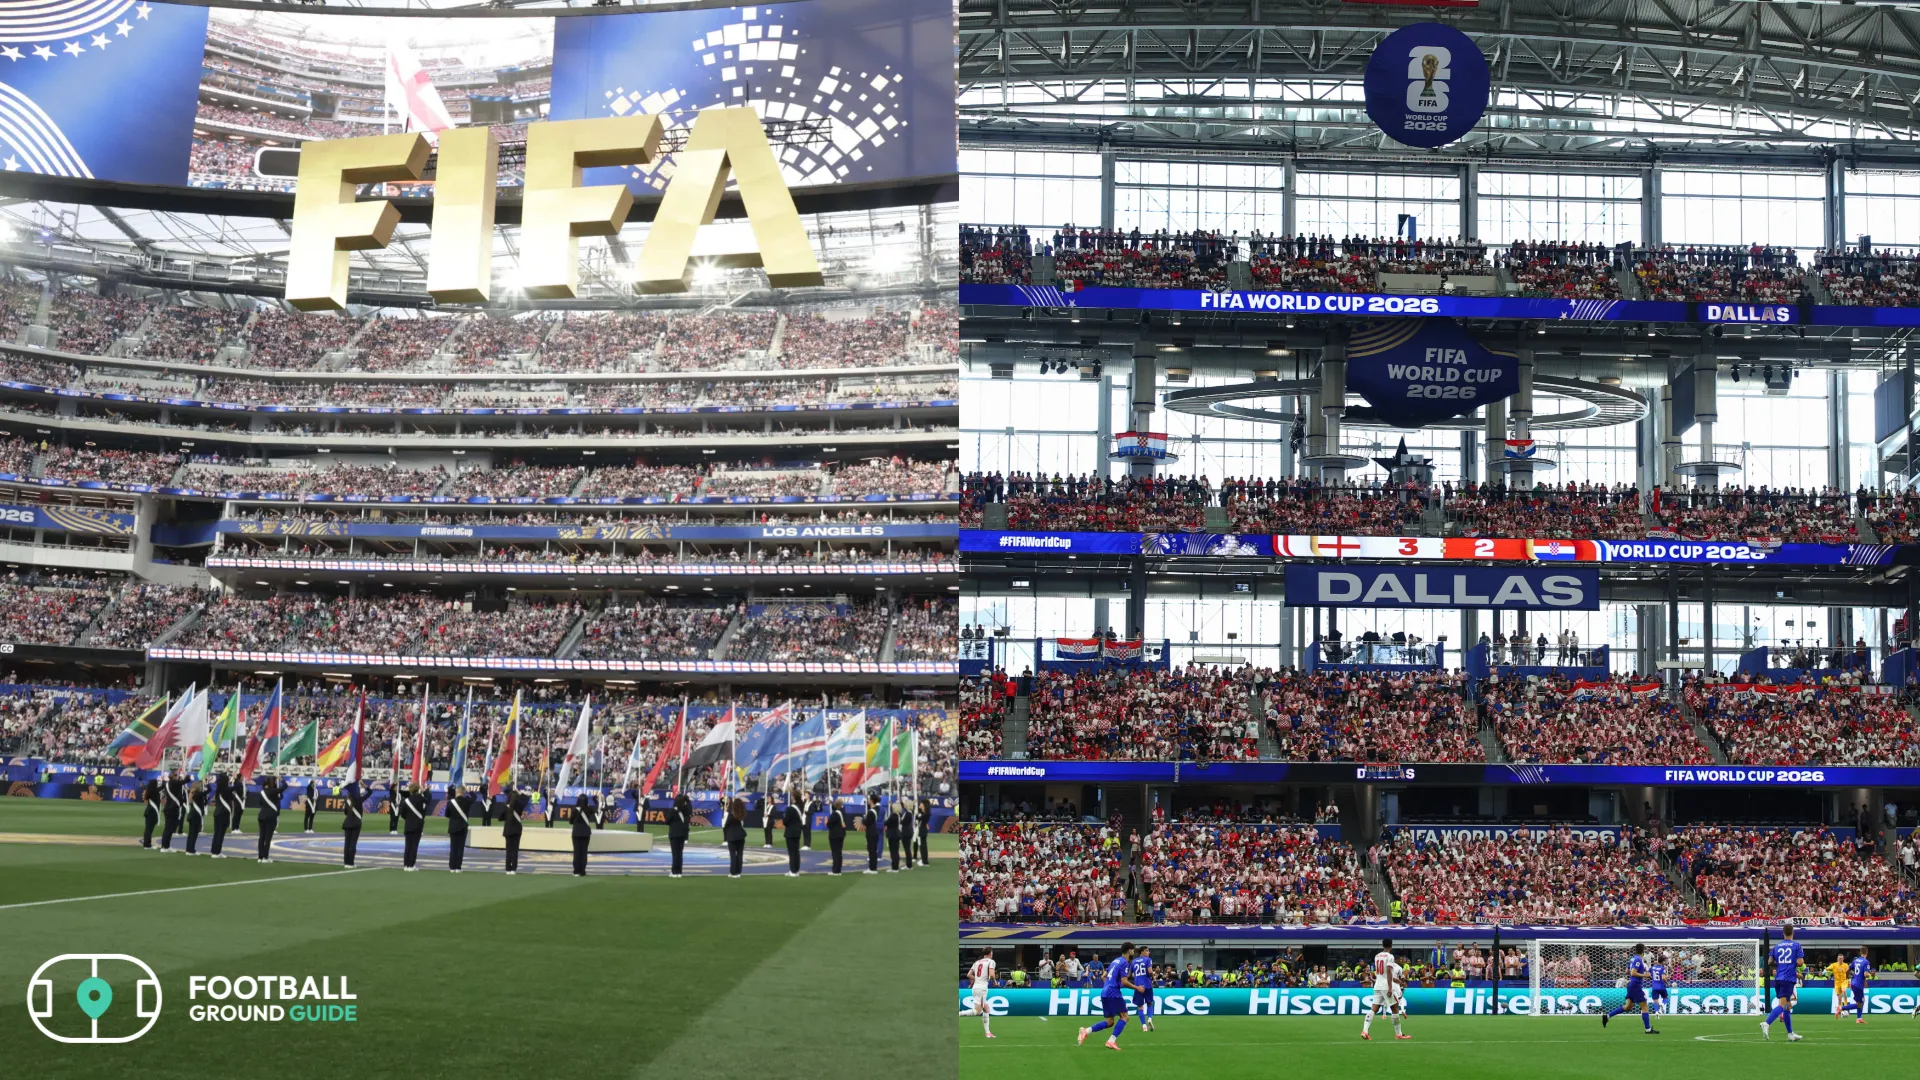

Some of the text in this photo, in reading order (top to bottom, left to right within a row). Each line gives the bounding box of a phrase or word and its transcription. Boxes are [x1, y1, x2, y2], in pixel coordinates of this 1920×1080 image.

[1404, 121, 1448, 131] 2026
[286, 106, 824, 311] FIFA
[1201, 293, 1438, 313] FIFA WORLD CUP 2026
[1708, 306, 1789, 322] DALLAS
[1425, 348, 1467, 364] FIFA
[1387, 364, 1502, 383] WORLD CUP
[1406, 385, 1477, 399] 2026
[1119, 448, 1162, 456] INJANI
[421, 527, 473, 537] #FIFAWorldCup
[763, 527, 884, 537] LOS ANGELES
[1000, 537, 1071, 549] #FIFAWorldCup
[1398, 538, 1418, 556] 3
[1475, 539, 1494, 556] 2
[1610, 544, 1666, 558] WORLD
[1669, 545, 1703, 558] CUP
[1318, 572, 1584, 606] DALLAS
[101, 767, 115, 775] FIFA
[988, 767, 1045, 777] #FIFAWorldCup
[1357, 768, 1415, 779] DAS
[1665, 770, 1824, 782] FIFA WORLD CUP 2026
[113, 788, 136, 799] FIFA
[325, 798, 345, 810] FIF
[560, 807, 572, 819] FI
[645, 811, 666, 822] IFA
[816, 816, 829, 827] FI
[1403, 829, 1438, 845] IFA
[1441, 829, 1508, 847] WORLD
[1558, 830, 1615, 846] 026
[1793, 917, 1808, 925] STO
[1777, 948, 1792, 964] 22
[977, 964, 983, 977] 8
[1107, 965, 1116, 980] 4
[1134, 963, 1146, 977] 26
[1375, 960, 1384, 975] 10
